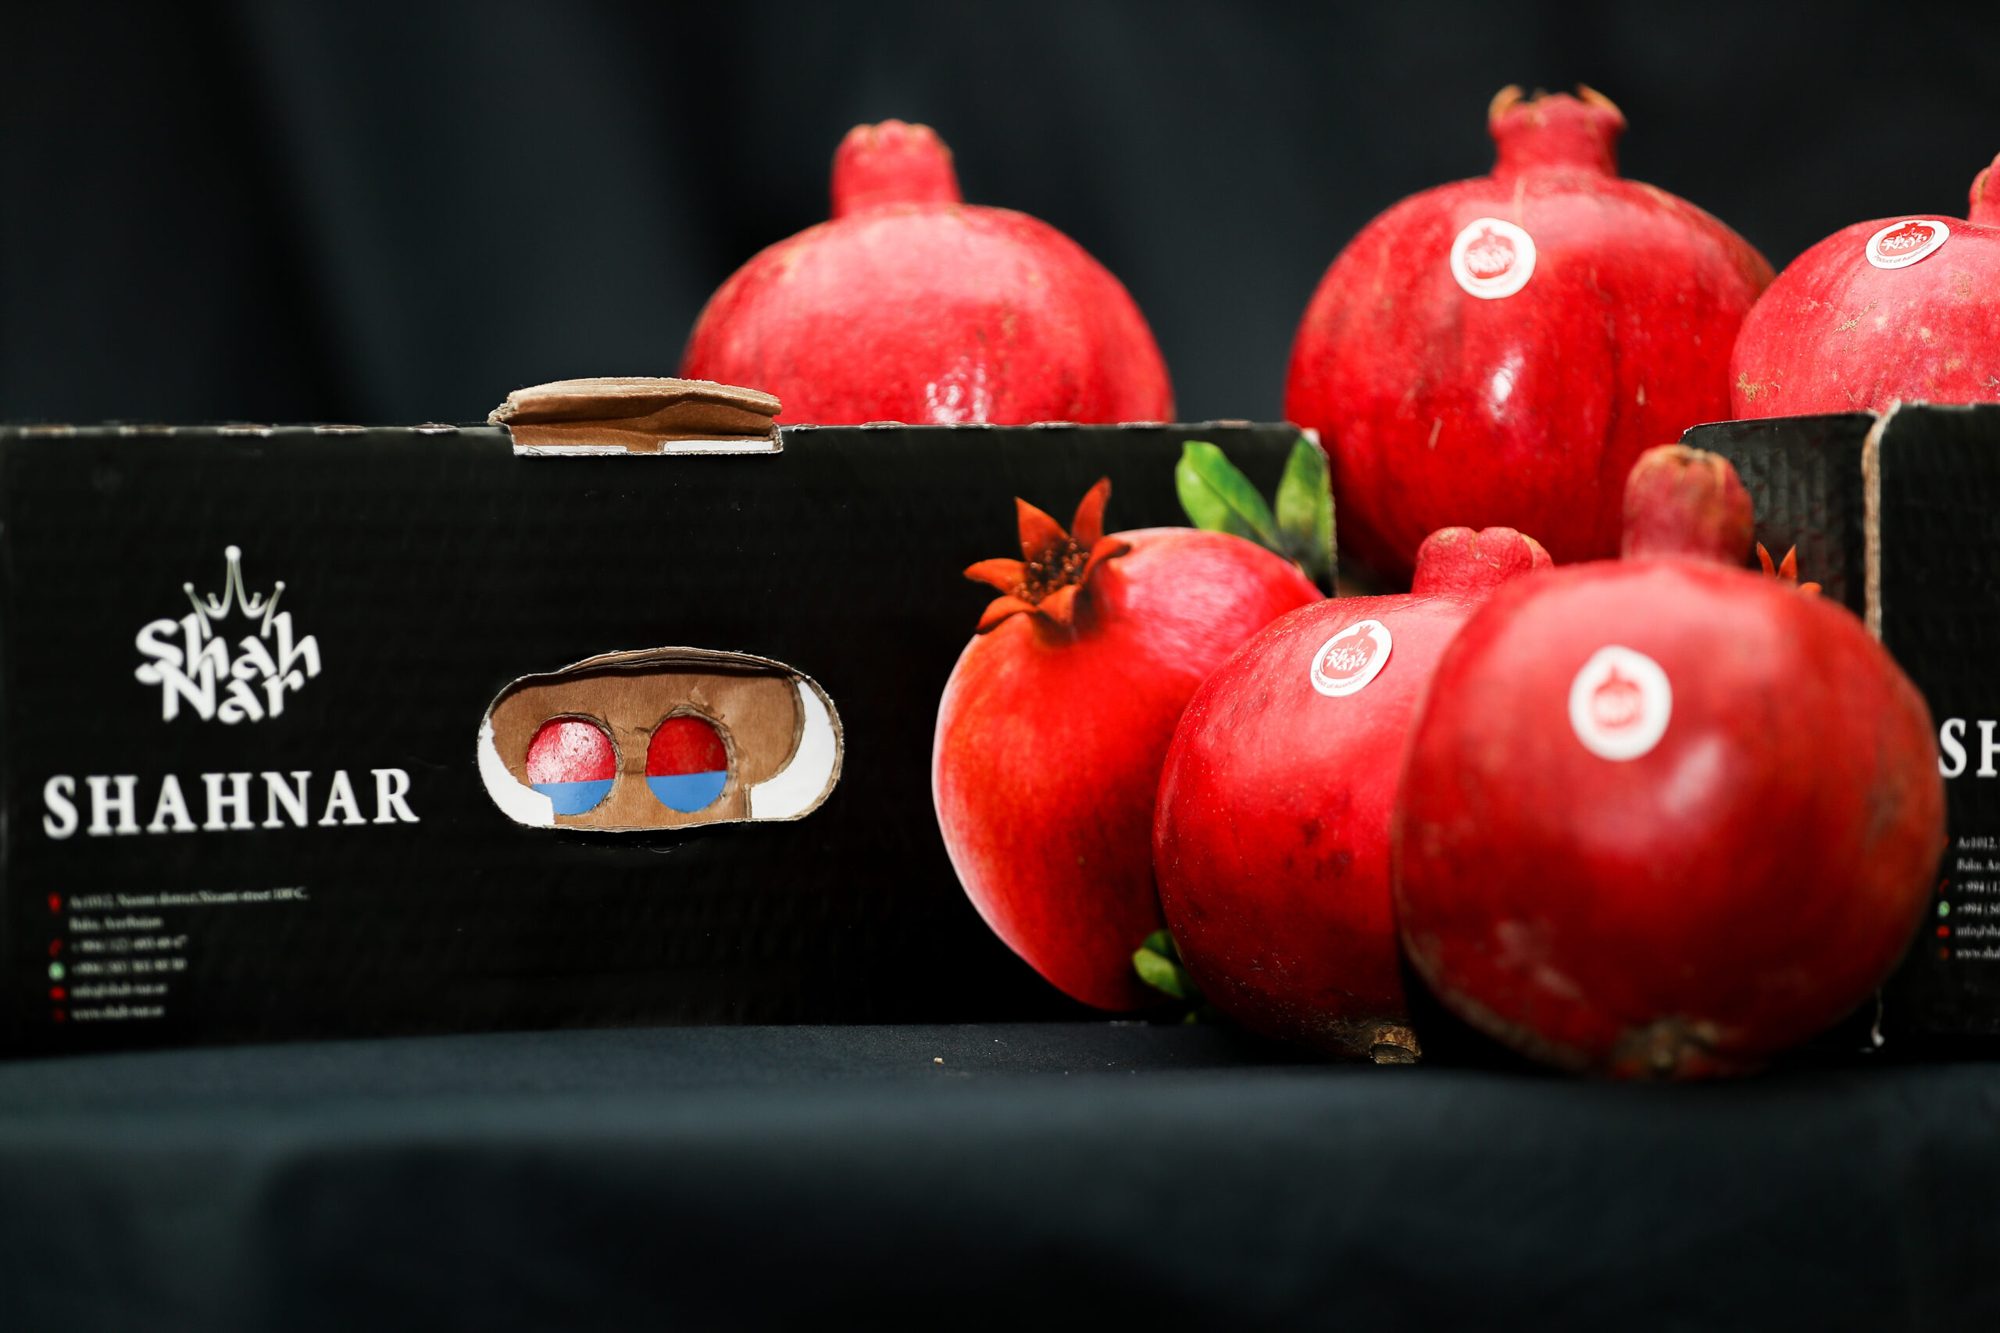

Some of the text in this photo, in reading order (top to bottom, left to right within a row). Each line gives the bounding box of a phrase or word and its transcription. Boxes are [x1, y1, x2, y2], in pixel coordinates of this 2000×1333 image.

[135, 612, 321, 680] Shah
[135, 654, 305, 725] Nar
[42, 768, 420, 840] SHAHNAR
